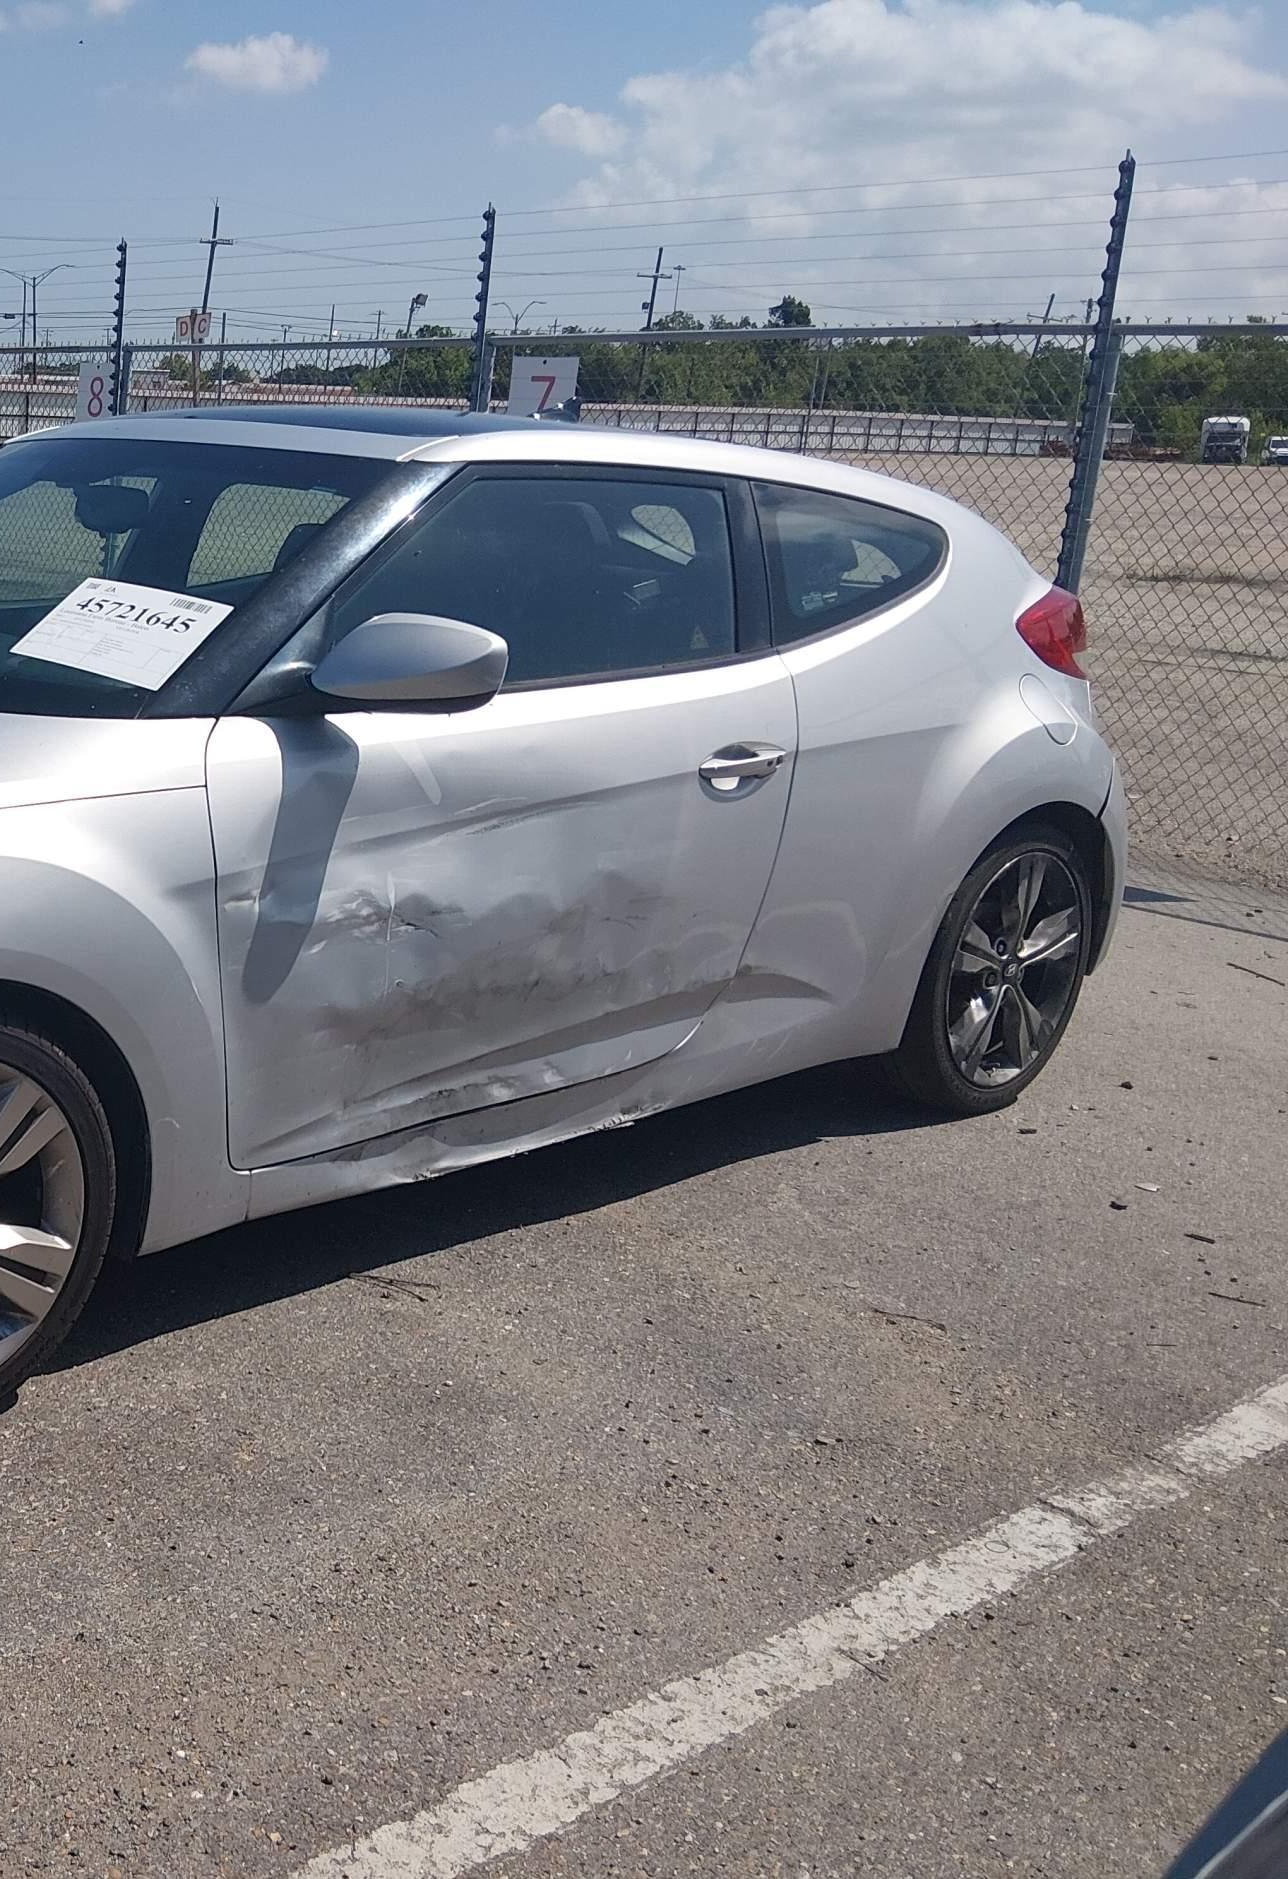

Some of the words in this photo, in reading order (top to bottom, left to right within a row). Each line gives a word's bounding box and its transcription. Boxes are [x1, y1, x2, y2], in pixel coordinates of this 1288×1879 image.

[180, 321, 189, 337] D
[198, 318, 207, 334] C
[87, 376, 104, 418] 8
[531, 376, 556, 413] 7
[76, 597, 196, 633] 45721645
